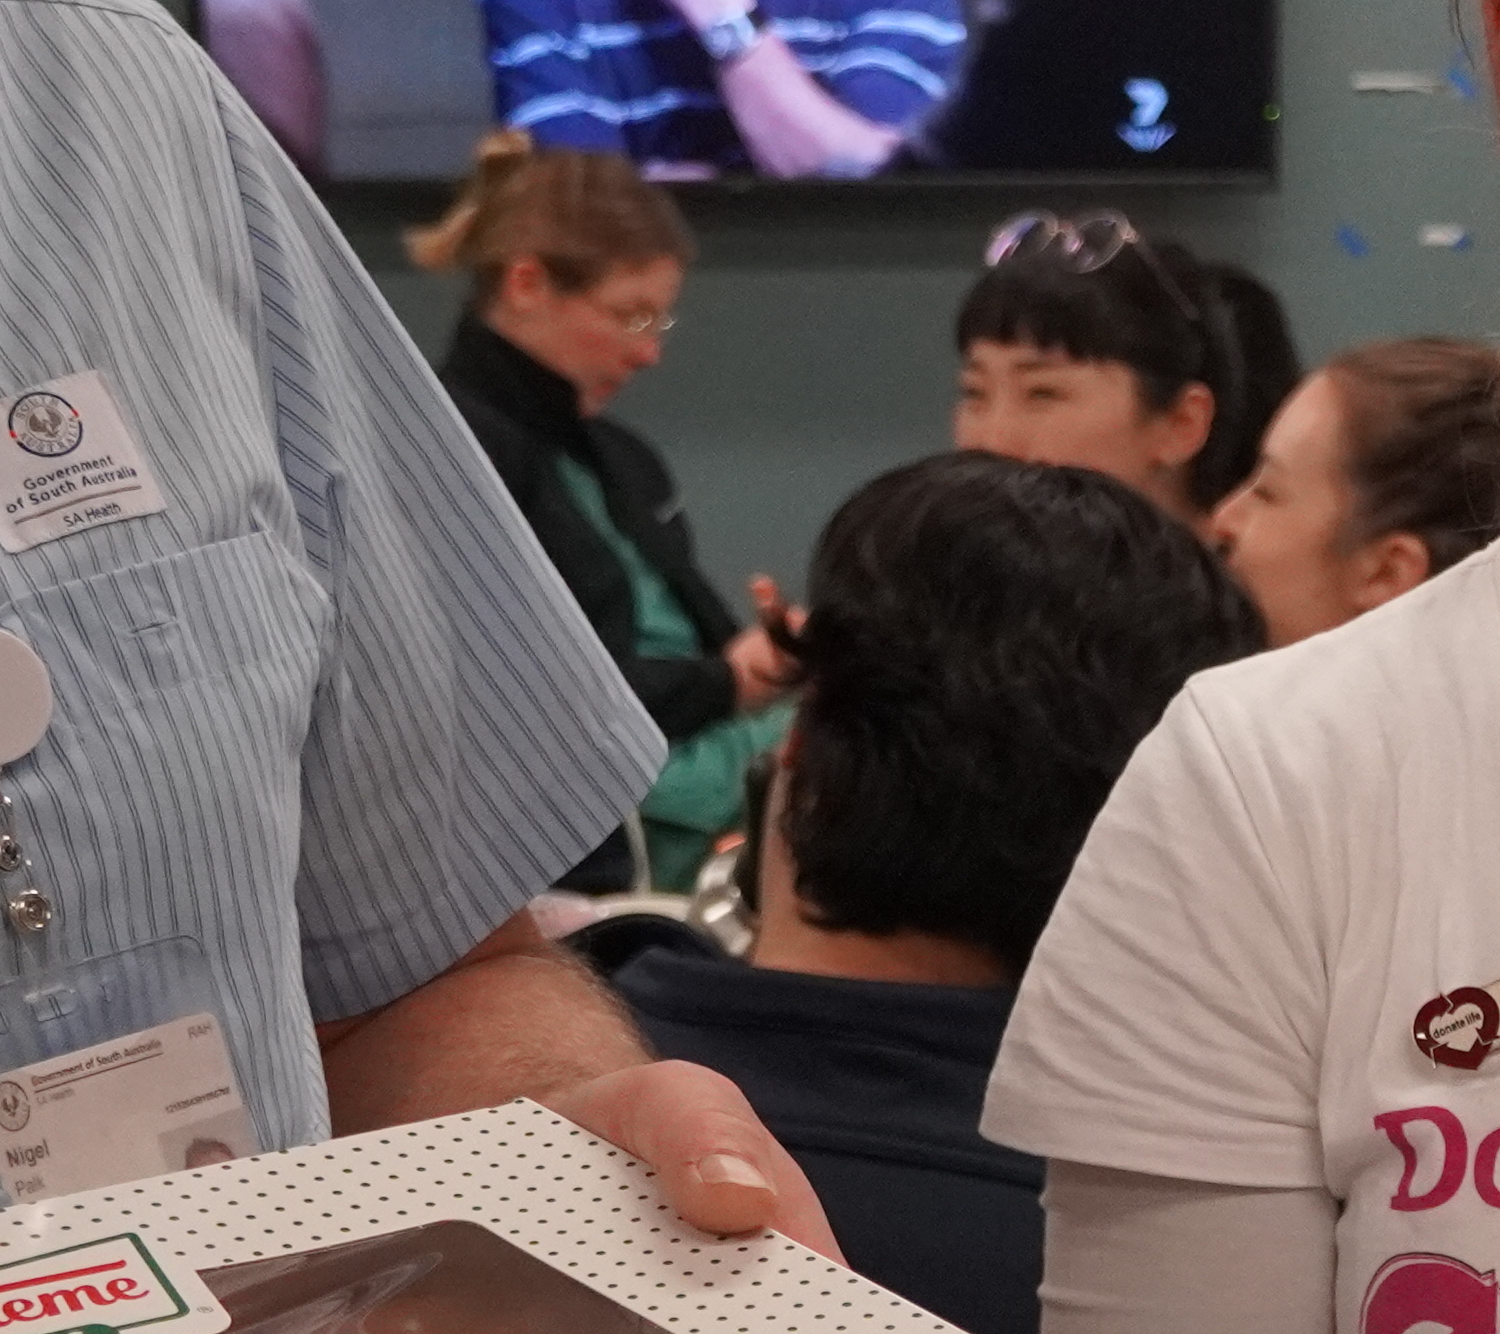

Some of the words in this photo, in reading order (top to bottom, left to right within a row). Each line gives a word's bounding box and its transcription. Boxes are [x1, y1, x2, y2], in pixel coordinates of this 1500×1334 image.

[23, 455, 114, 490] Government
[5, 497, 25, 514] of
[29, 480, 76, 506] South
[81, 466, 137, 488] Australia
[63, 512, 82, 528] SA
[85, 501, 122, 524] Health
[1433, 1019, 1465, 1040] donate
[1465, 1011, 1482, 1028] life
[85, 1057, 95, 1069] of
[96, 1052, 123, 1067] South
[5, 1139, 50, 1167] Nigel
